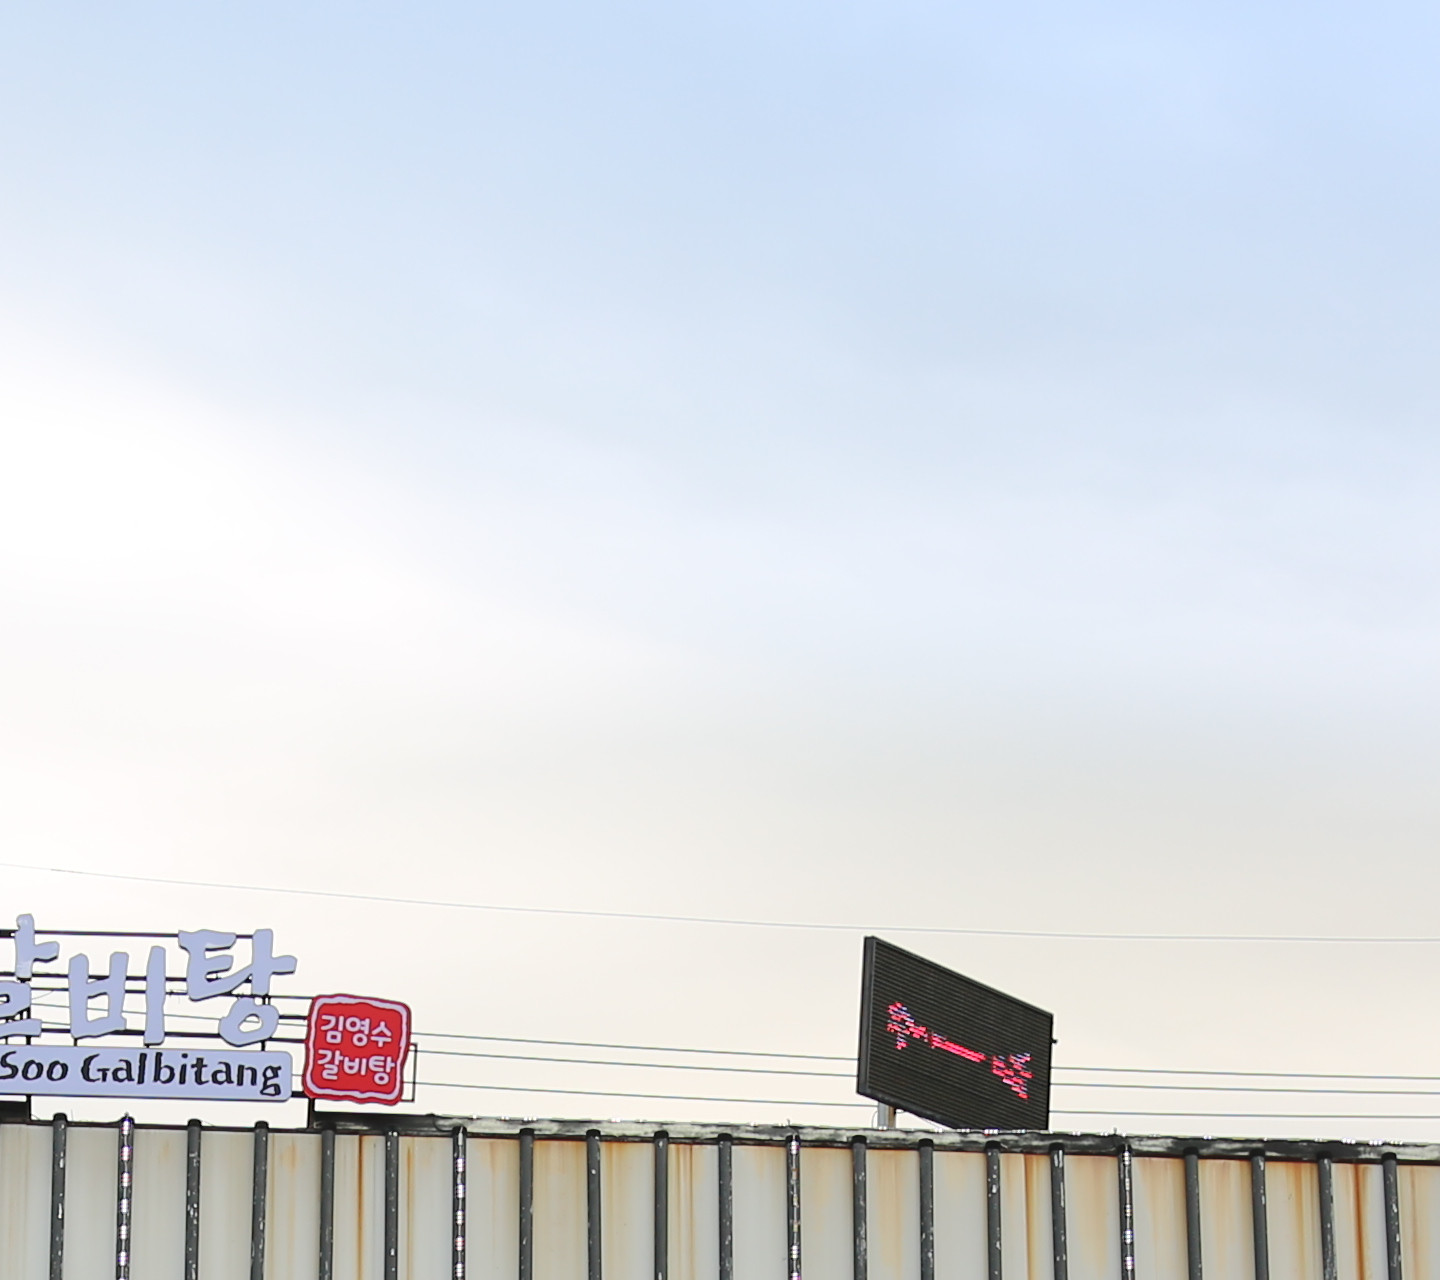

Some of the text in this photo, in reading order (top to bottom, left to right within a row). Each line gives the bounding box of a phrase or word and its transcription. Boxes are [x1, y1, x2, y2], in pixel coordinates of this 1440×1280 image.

[318, 1013, 395, 1047] 김영수
[81, 1051, 284, 1097] Galbitang
[316, 1048, 396, 1087] 갈비탕
